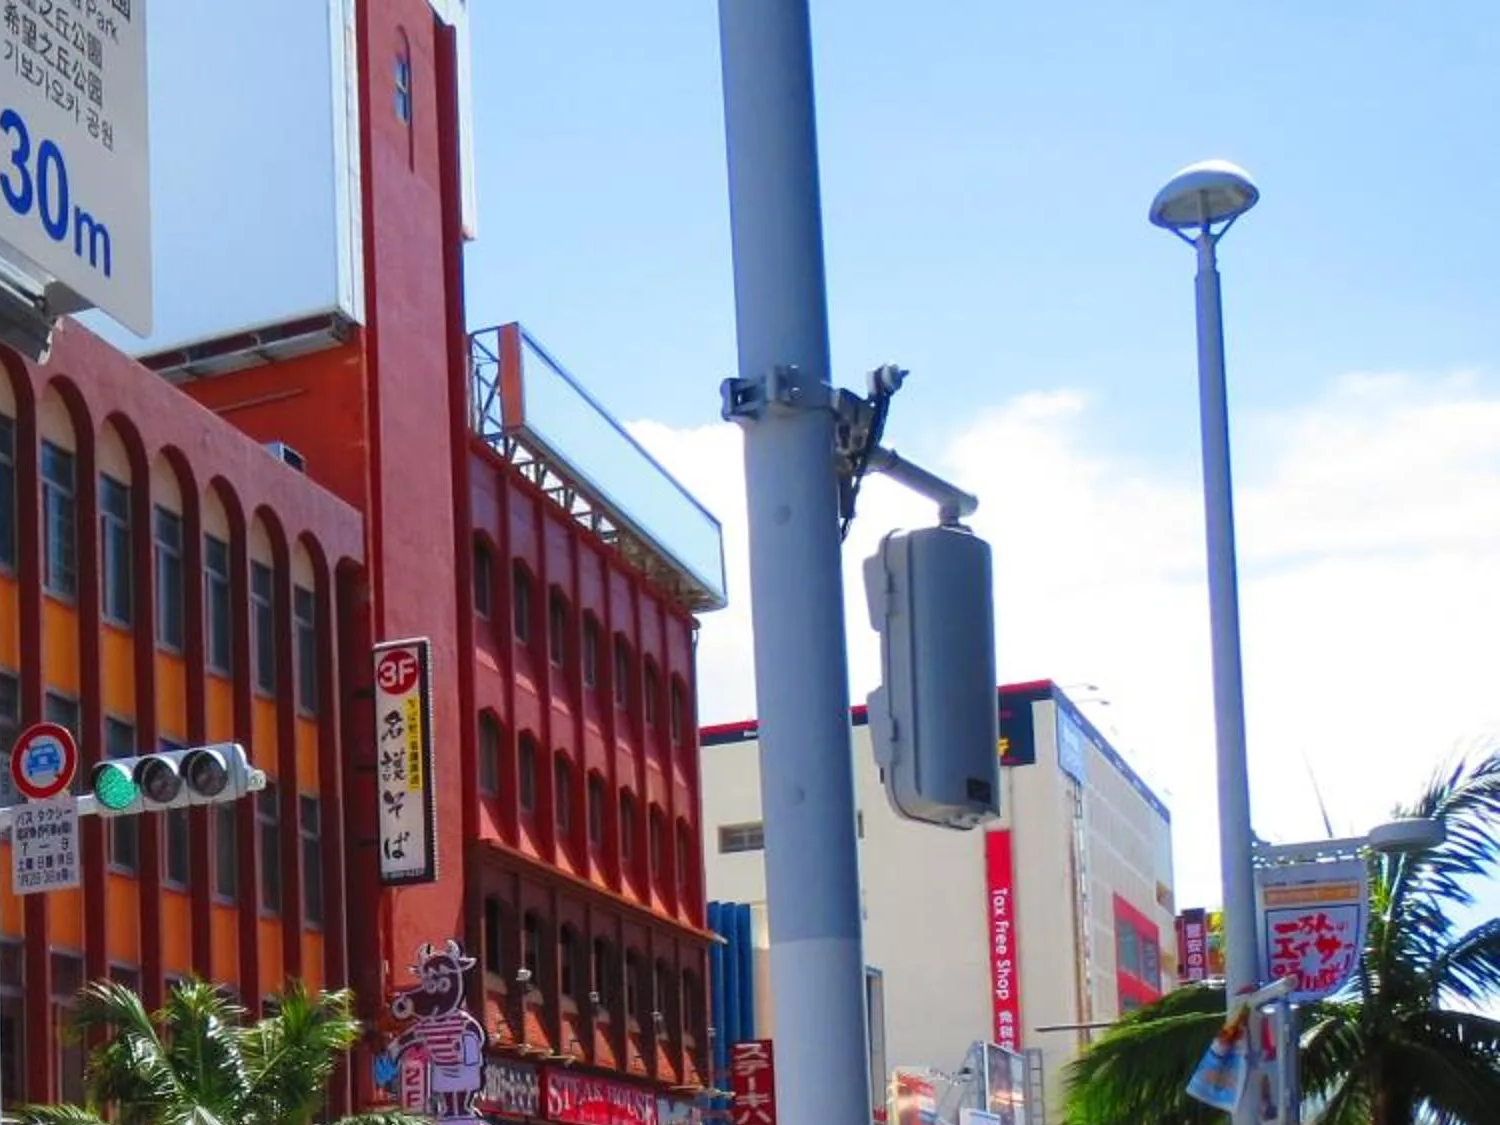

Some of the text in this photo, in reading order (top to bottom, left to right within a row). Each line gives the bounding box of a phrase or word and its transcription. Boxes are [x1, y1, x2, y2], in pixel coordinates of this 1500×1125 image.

[3, 38, 113, 152] 기보가오카 공원
[381, 662, 415, 688] 3F
[993, 887, 1007, 915] Tax
[997, 960, 1011, 1000] Shop
[547, 1075, 601, 1118] STEAK
